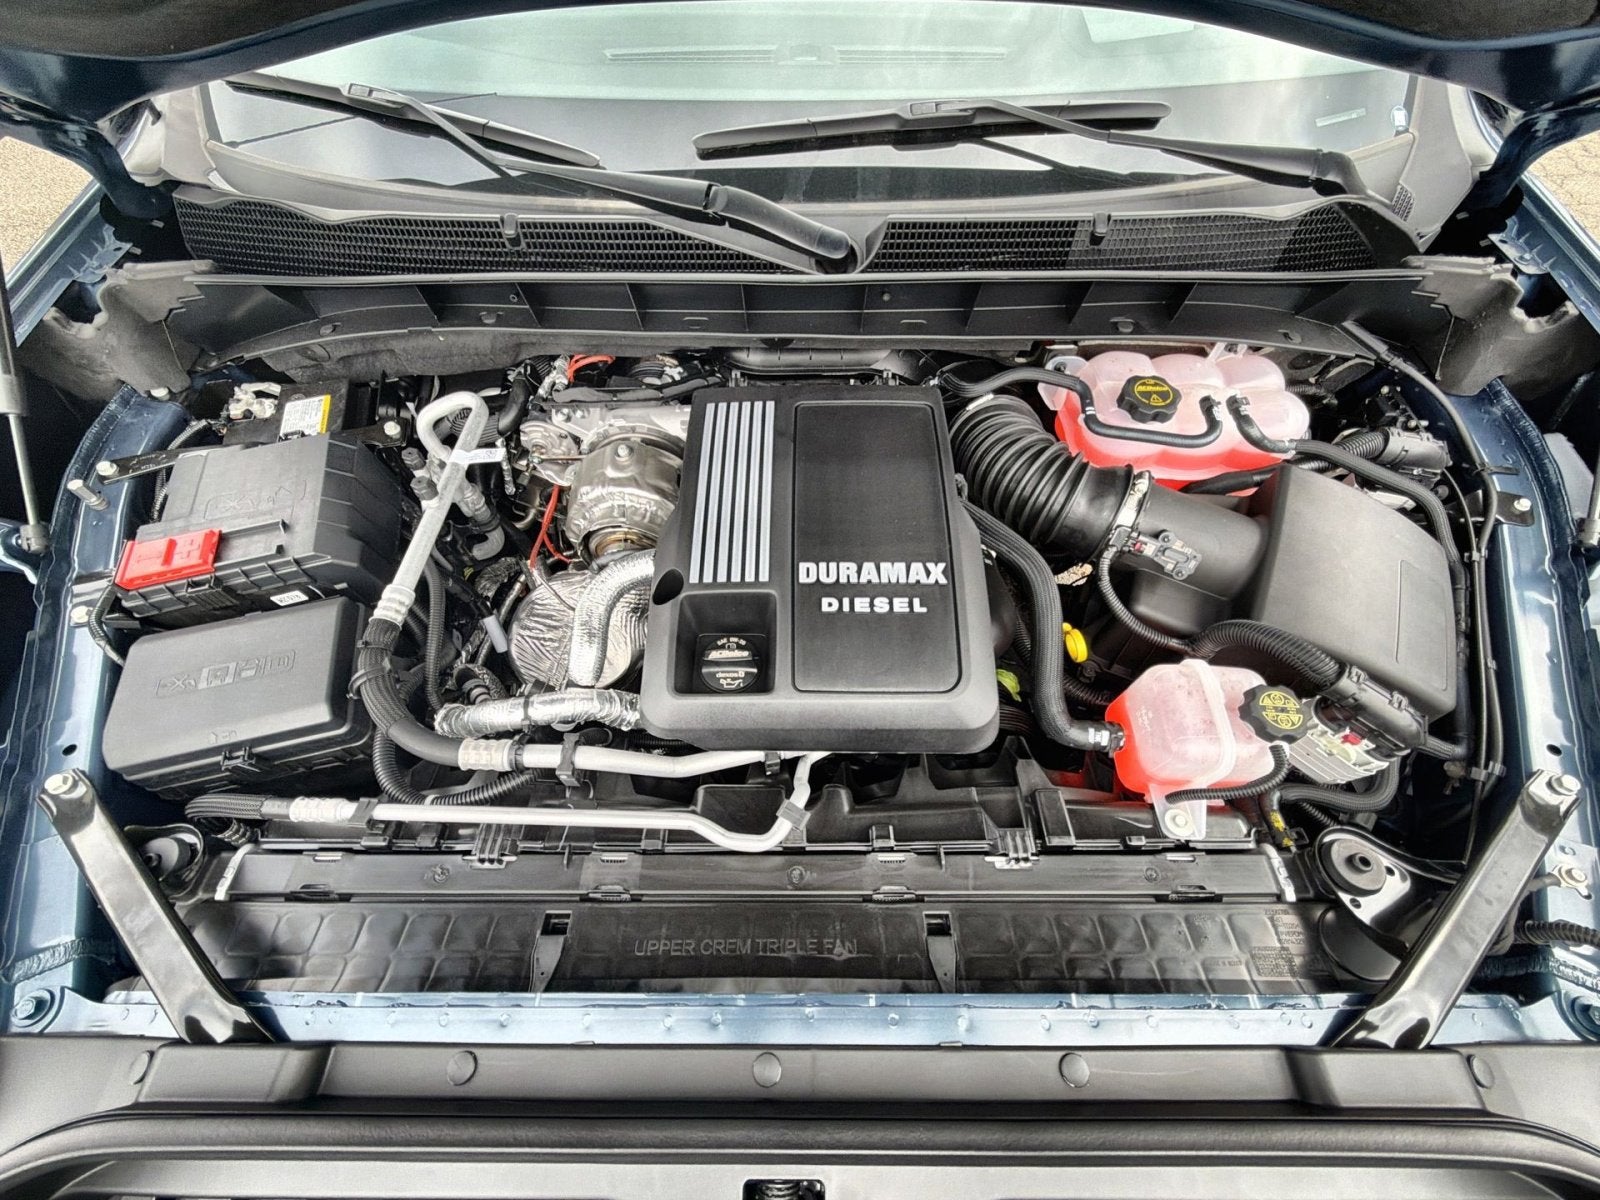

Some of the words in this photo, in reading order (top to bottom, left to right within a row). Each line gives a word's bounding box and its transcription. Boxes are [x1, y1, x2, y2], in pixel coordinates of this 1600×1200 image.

[798, 561, 949, 585] DURAMAX
[821, 597, 928, 613] DIESEL
[634, 939, 696, 956] UPPER
[755, 938, 819, 956] TRIPLE
[823, 938, 858, 956] FAN
